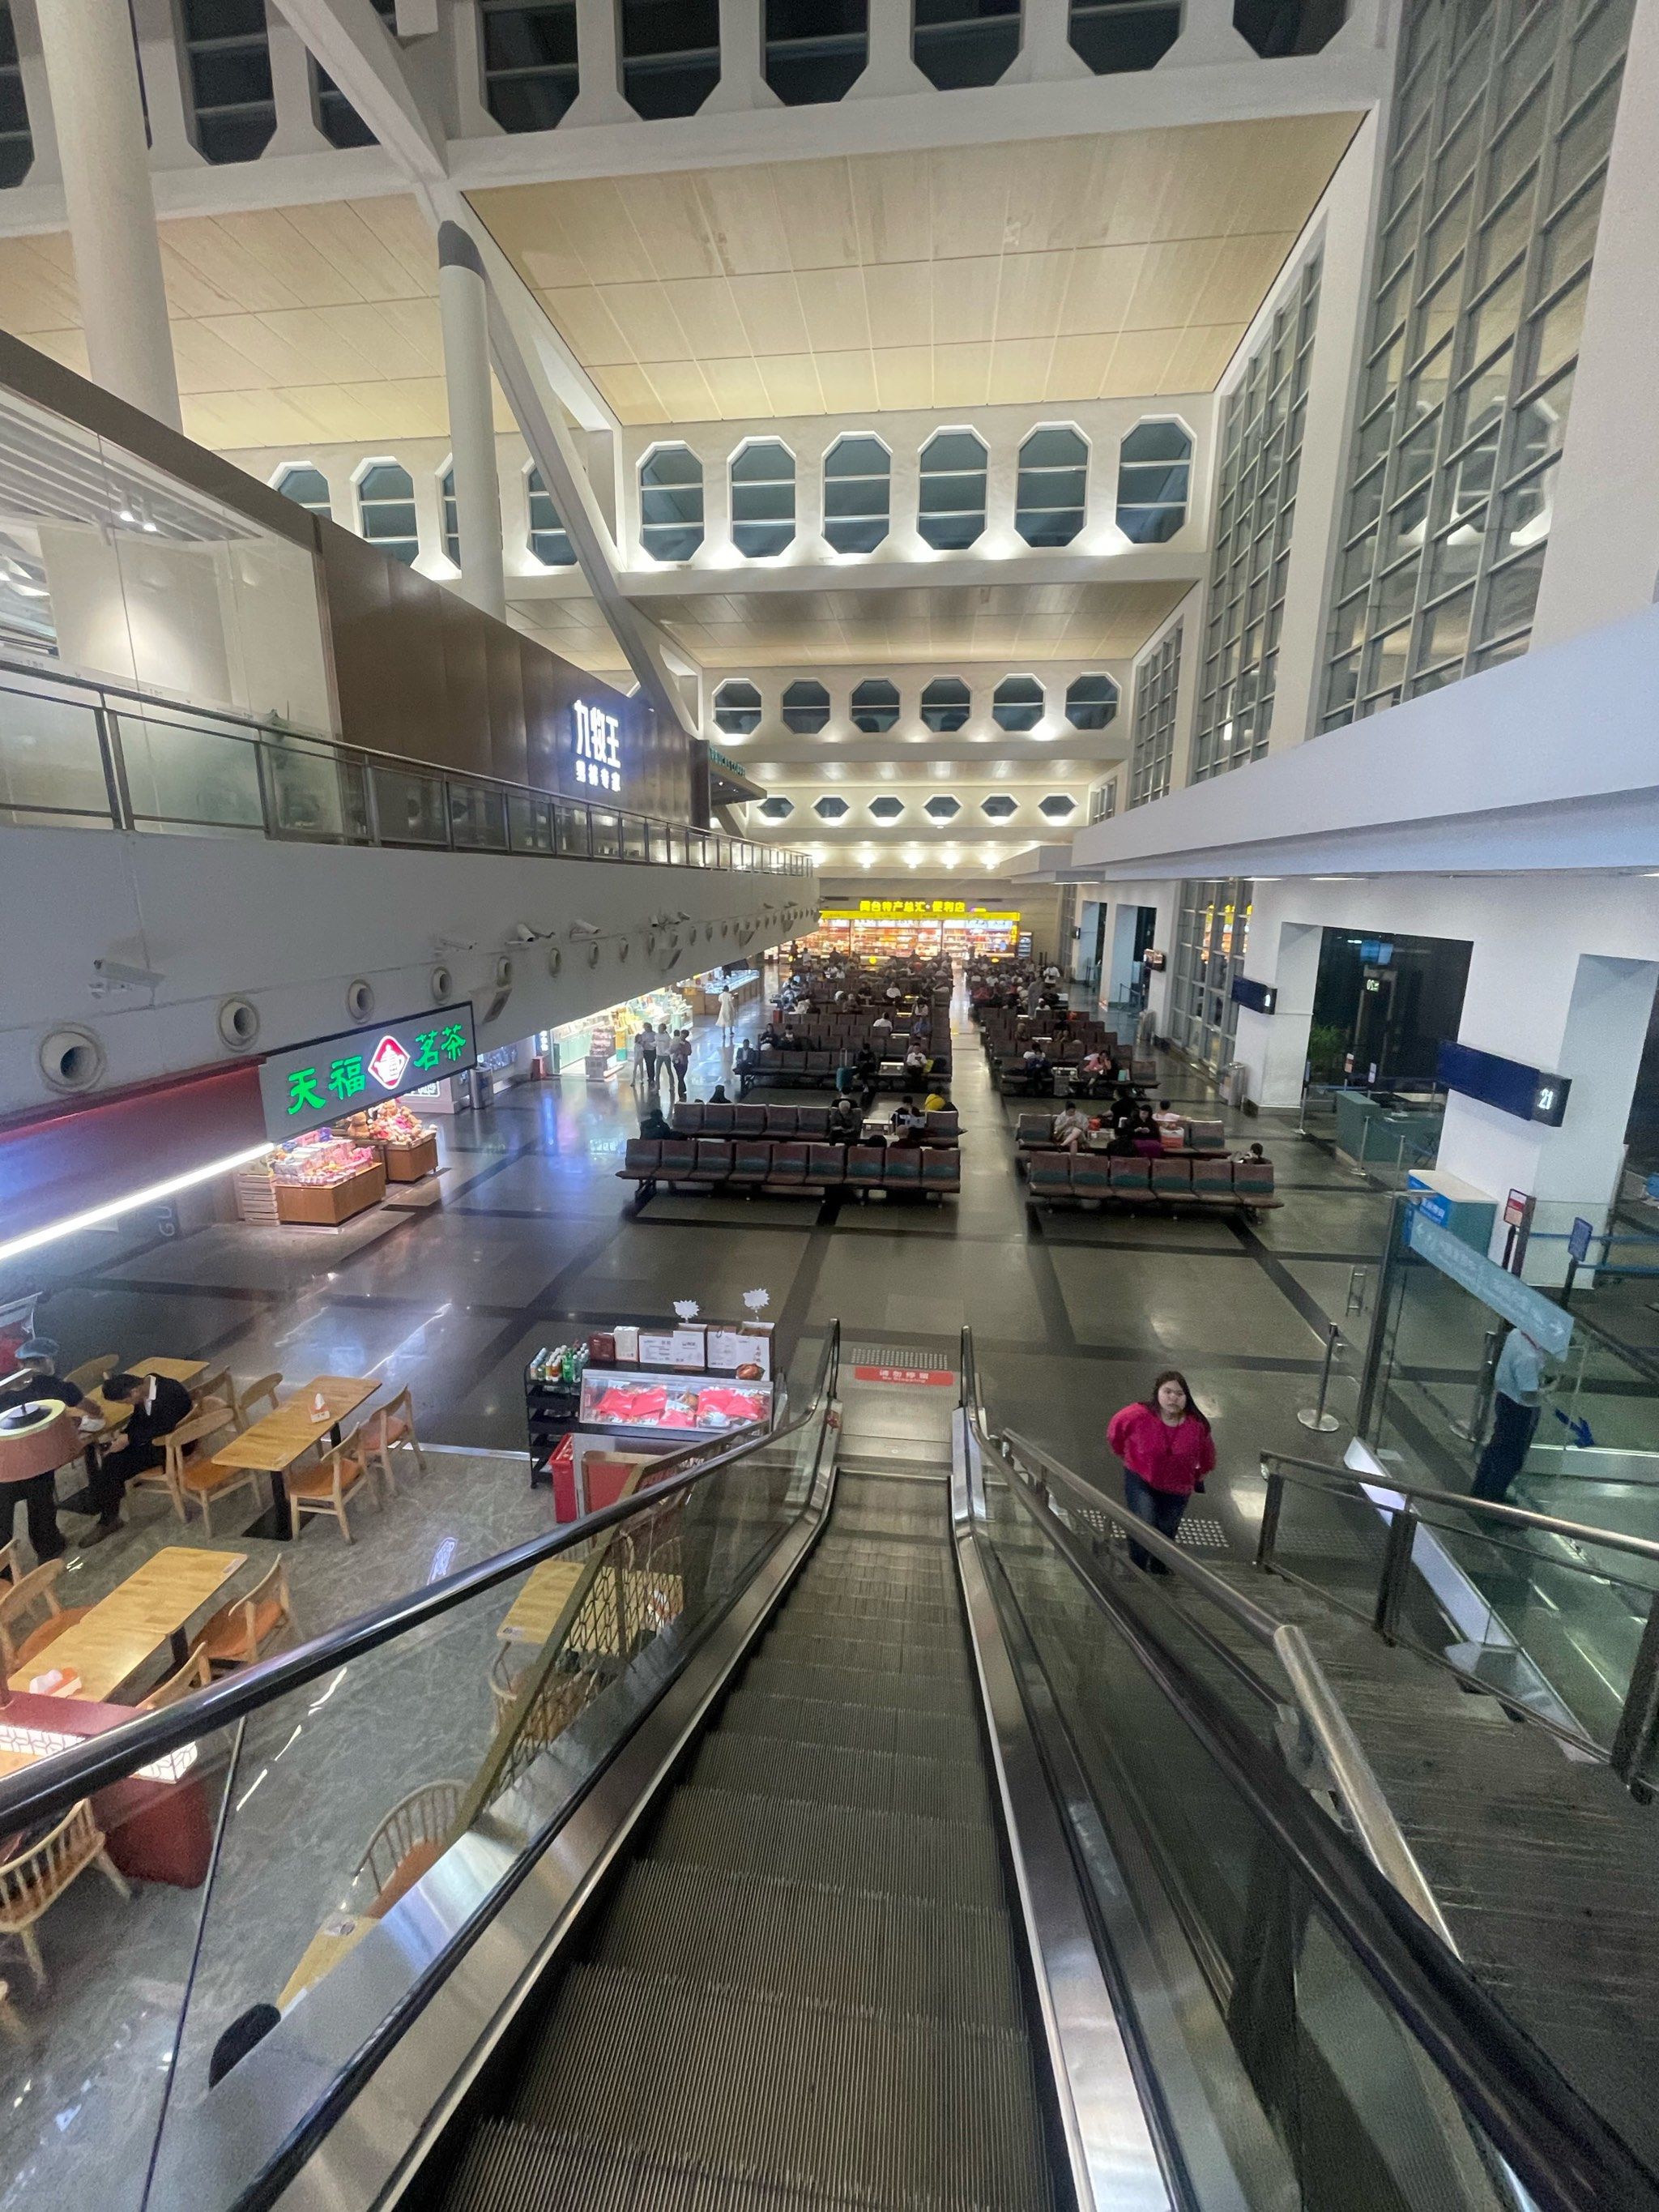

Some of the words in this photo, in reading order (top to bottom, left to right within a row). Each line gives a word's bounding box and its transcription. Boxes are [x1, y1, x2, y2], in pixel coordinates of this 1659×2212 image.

[287, 1055, 365, 1115] 天福
[413, 1023, 467, 1071] 茗茶
[1537, 1087, 1554, 1110] 21
